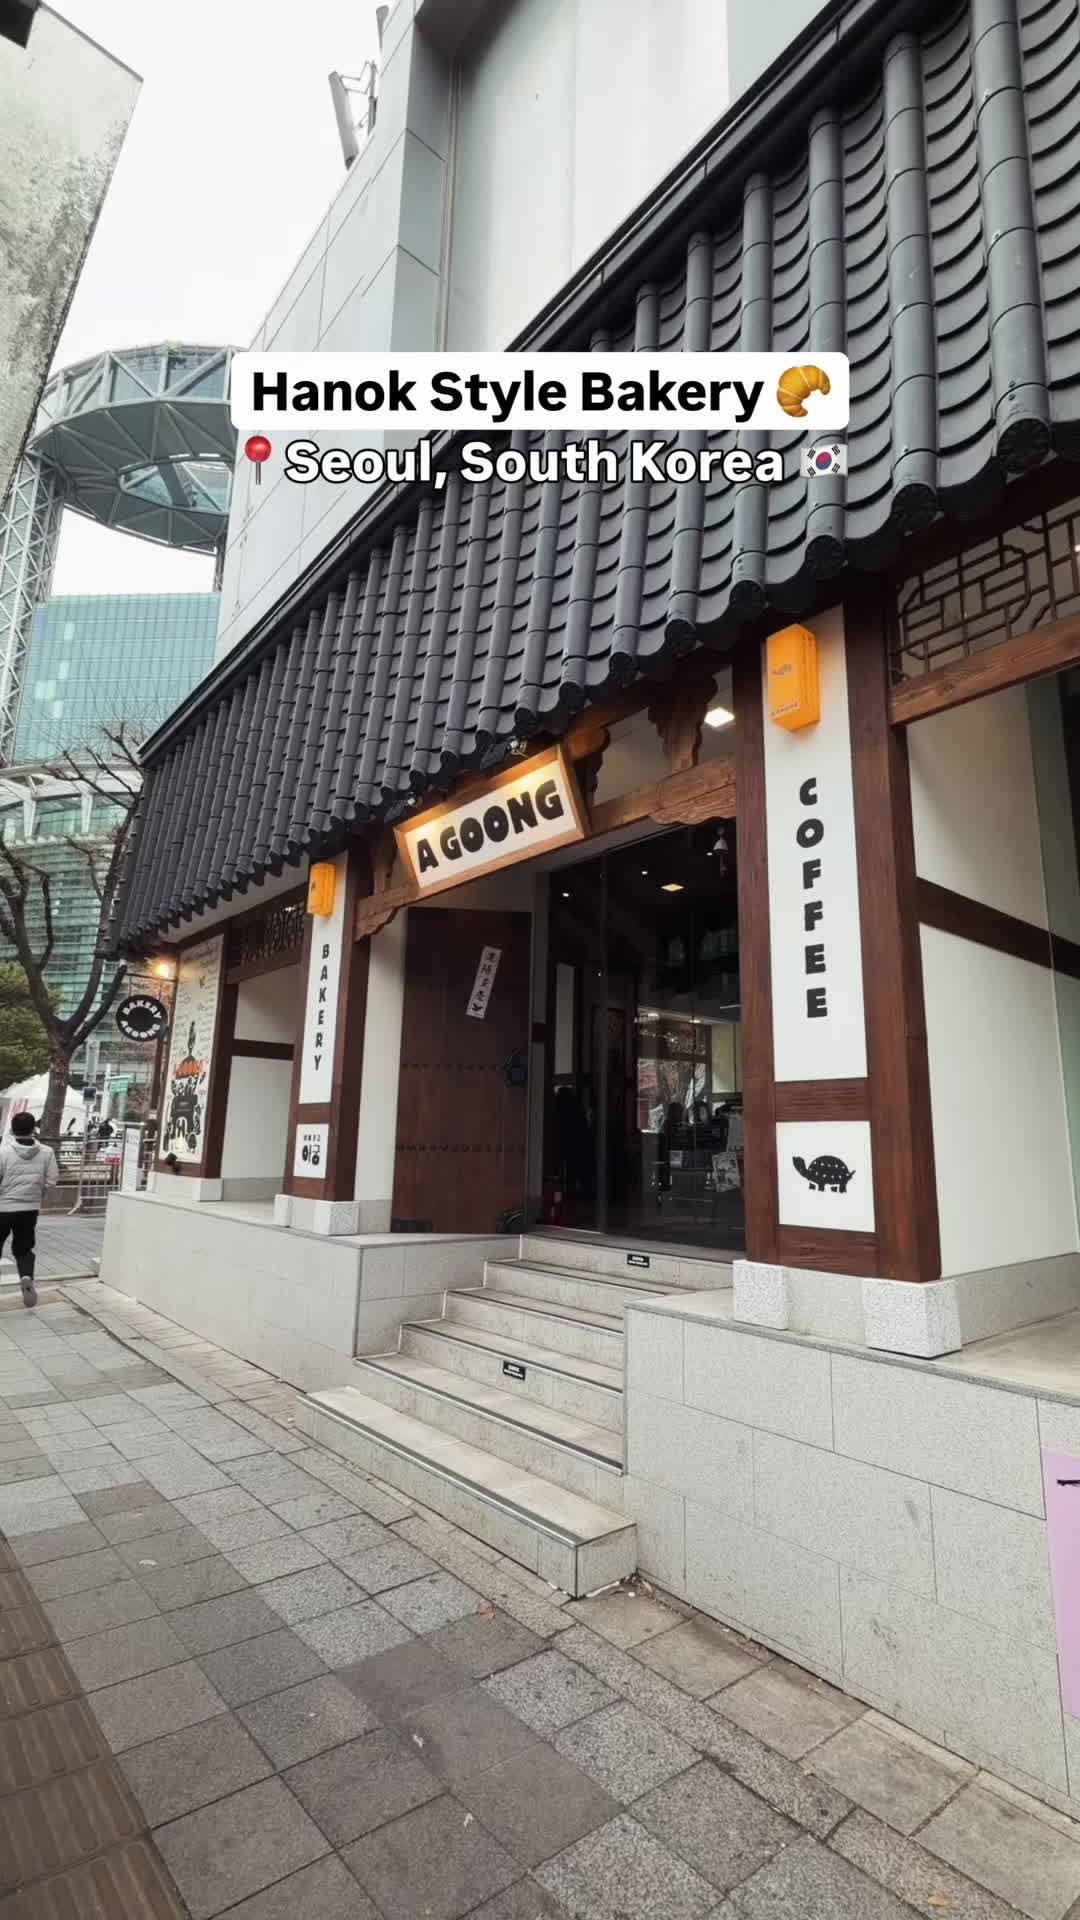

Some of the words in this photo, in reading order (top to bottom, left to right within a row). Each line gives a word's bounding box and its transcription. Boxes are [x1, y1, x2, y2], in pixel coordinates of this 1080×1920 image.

[796, 777, 828, 1018] COFFEE
[122, 1000, 161, 1019] BAKERY
[313, 943, 330, 1071] BAKERY
